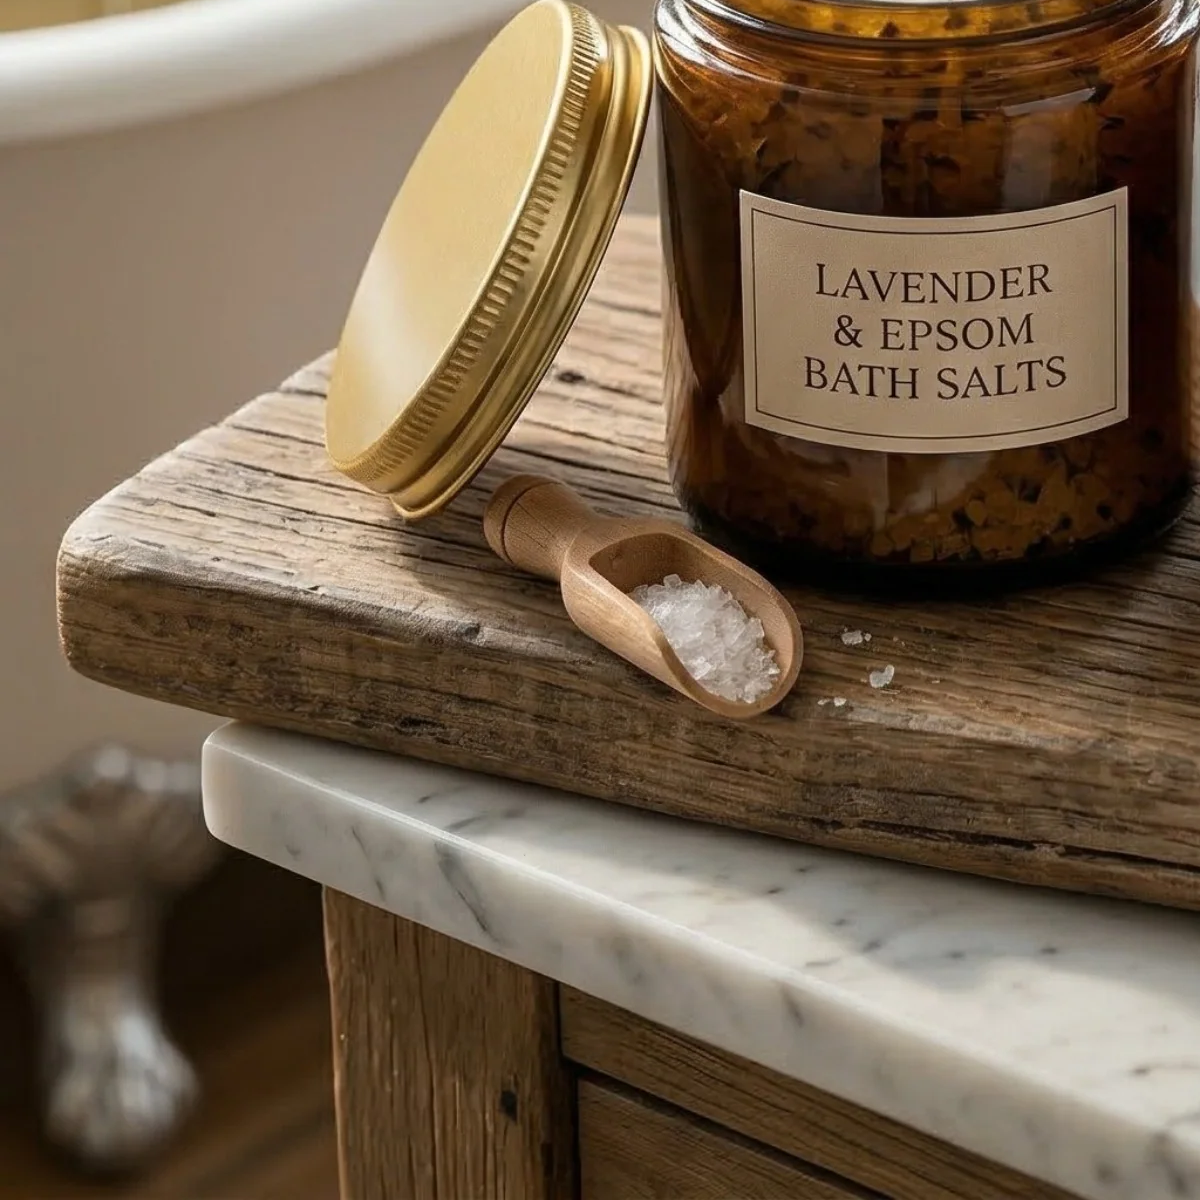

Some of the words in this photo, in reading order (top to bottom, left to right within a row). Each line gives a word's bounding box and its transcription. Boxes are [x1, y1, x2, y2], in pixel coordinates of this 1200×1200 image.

[815, 262, 1053, 304] LAVENDER
[833, 314, 863, 349] &
[880, 312, 1035, 352] EPSOM
[804, 355, 920, 400] BATH
[936, 355, 1067, 401] SALTS
